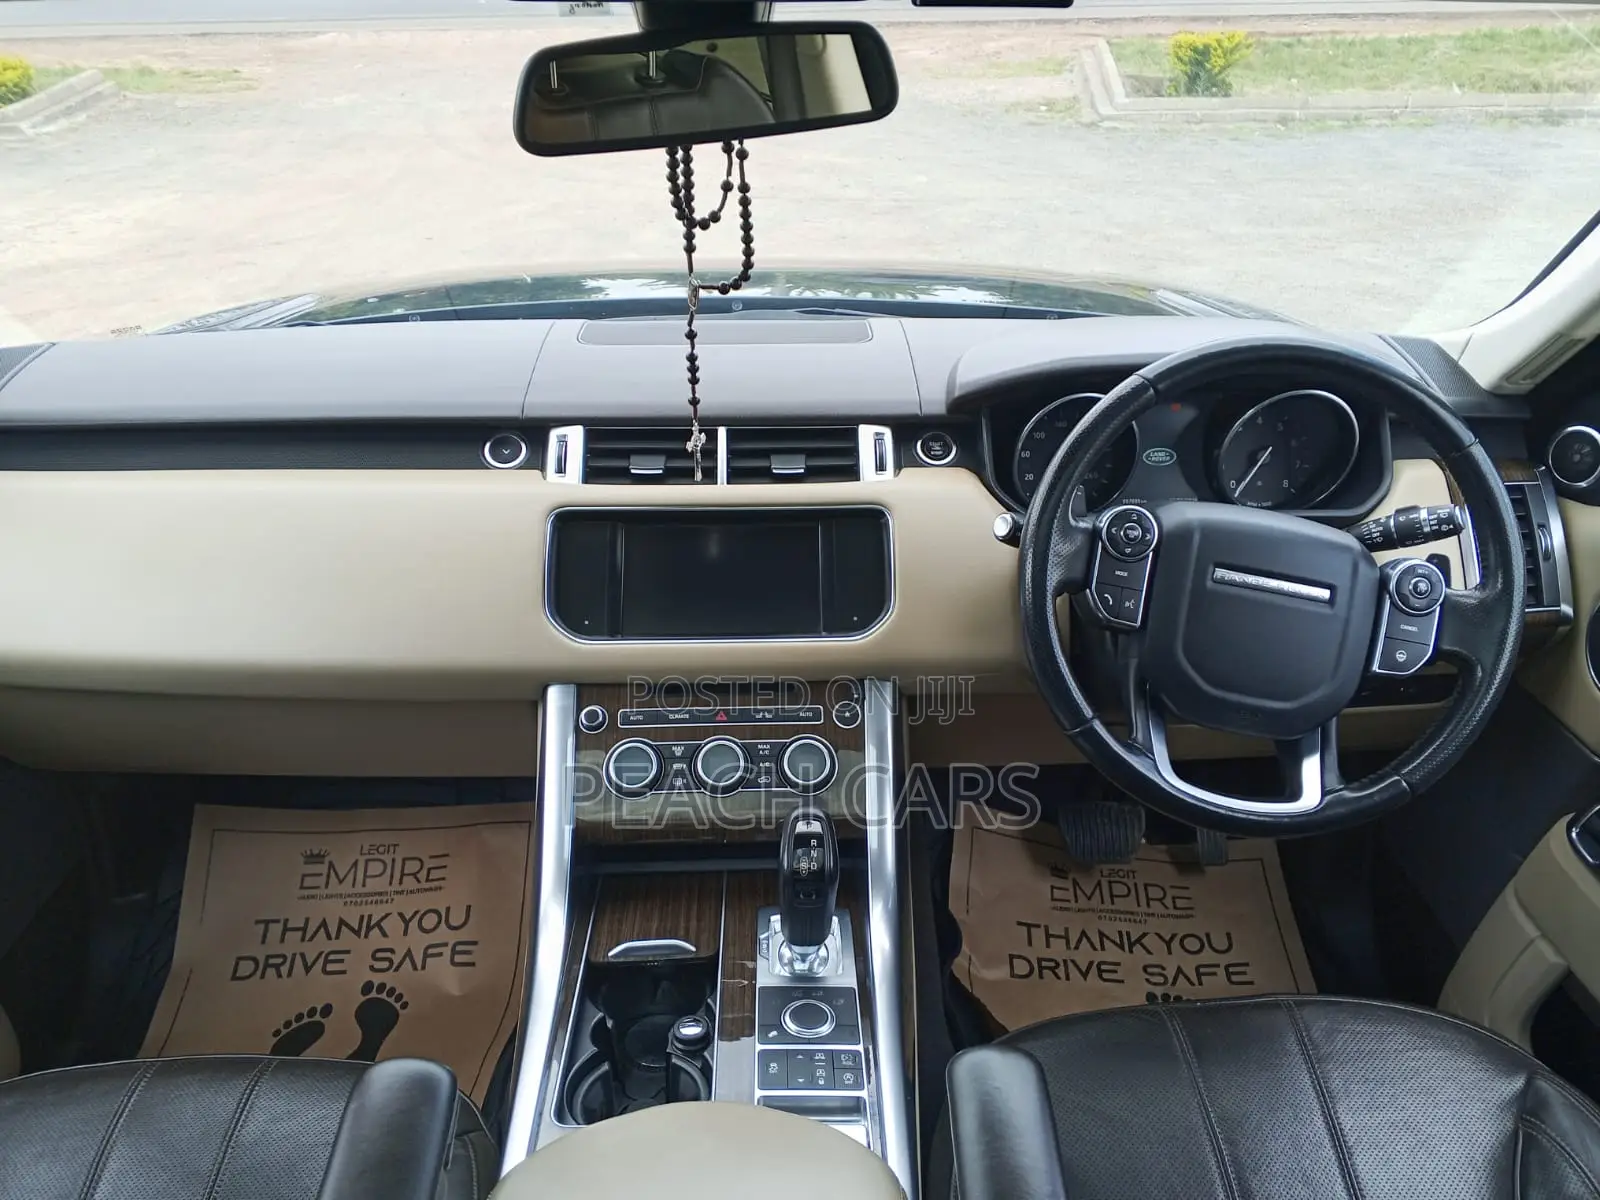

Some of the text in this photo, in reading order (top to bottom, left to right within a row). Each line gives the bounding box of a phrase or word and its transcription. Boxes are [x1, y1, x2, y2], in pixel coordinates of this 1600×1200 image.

[1033, 431, 1046, 439] 100
[1021, 450, 1031, 458] 60
[1230, 480, 1236, 488] 0
[359, 843, 400, 856] LEGIT
[810, 839, 817, 847] R
[299, 853, 450, 890] EMPIRE
[810, 862, 817, 870] D
[1100, 867, 1138, 880] LEGIT
[1050, 875, 1196, 911] EMPIRE
[230, 940, 479, 981] DRIVE SAFE
[1008, 953, 1255, 987] DRIVE SAFE
